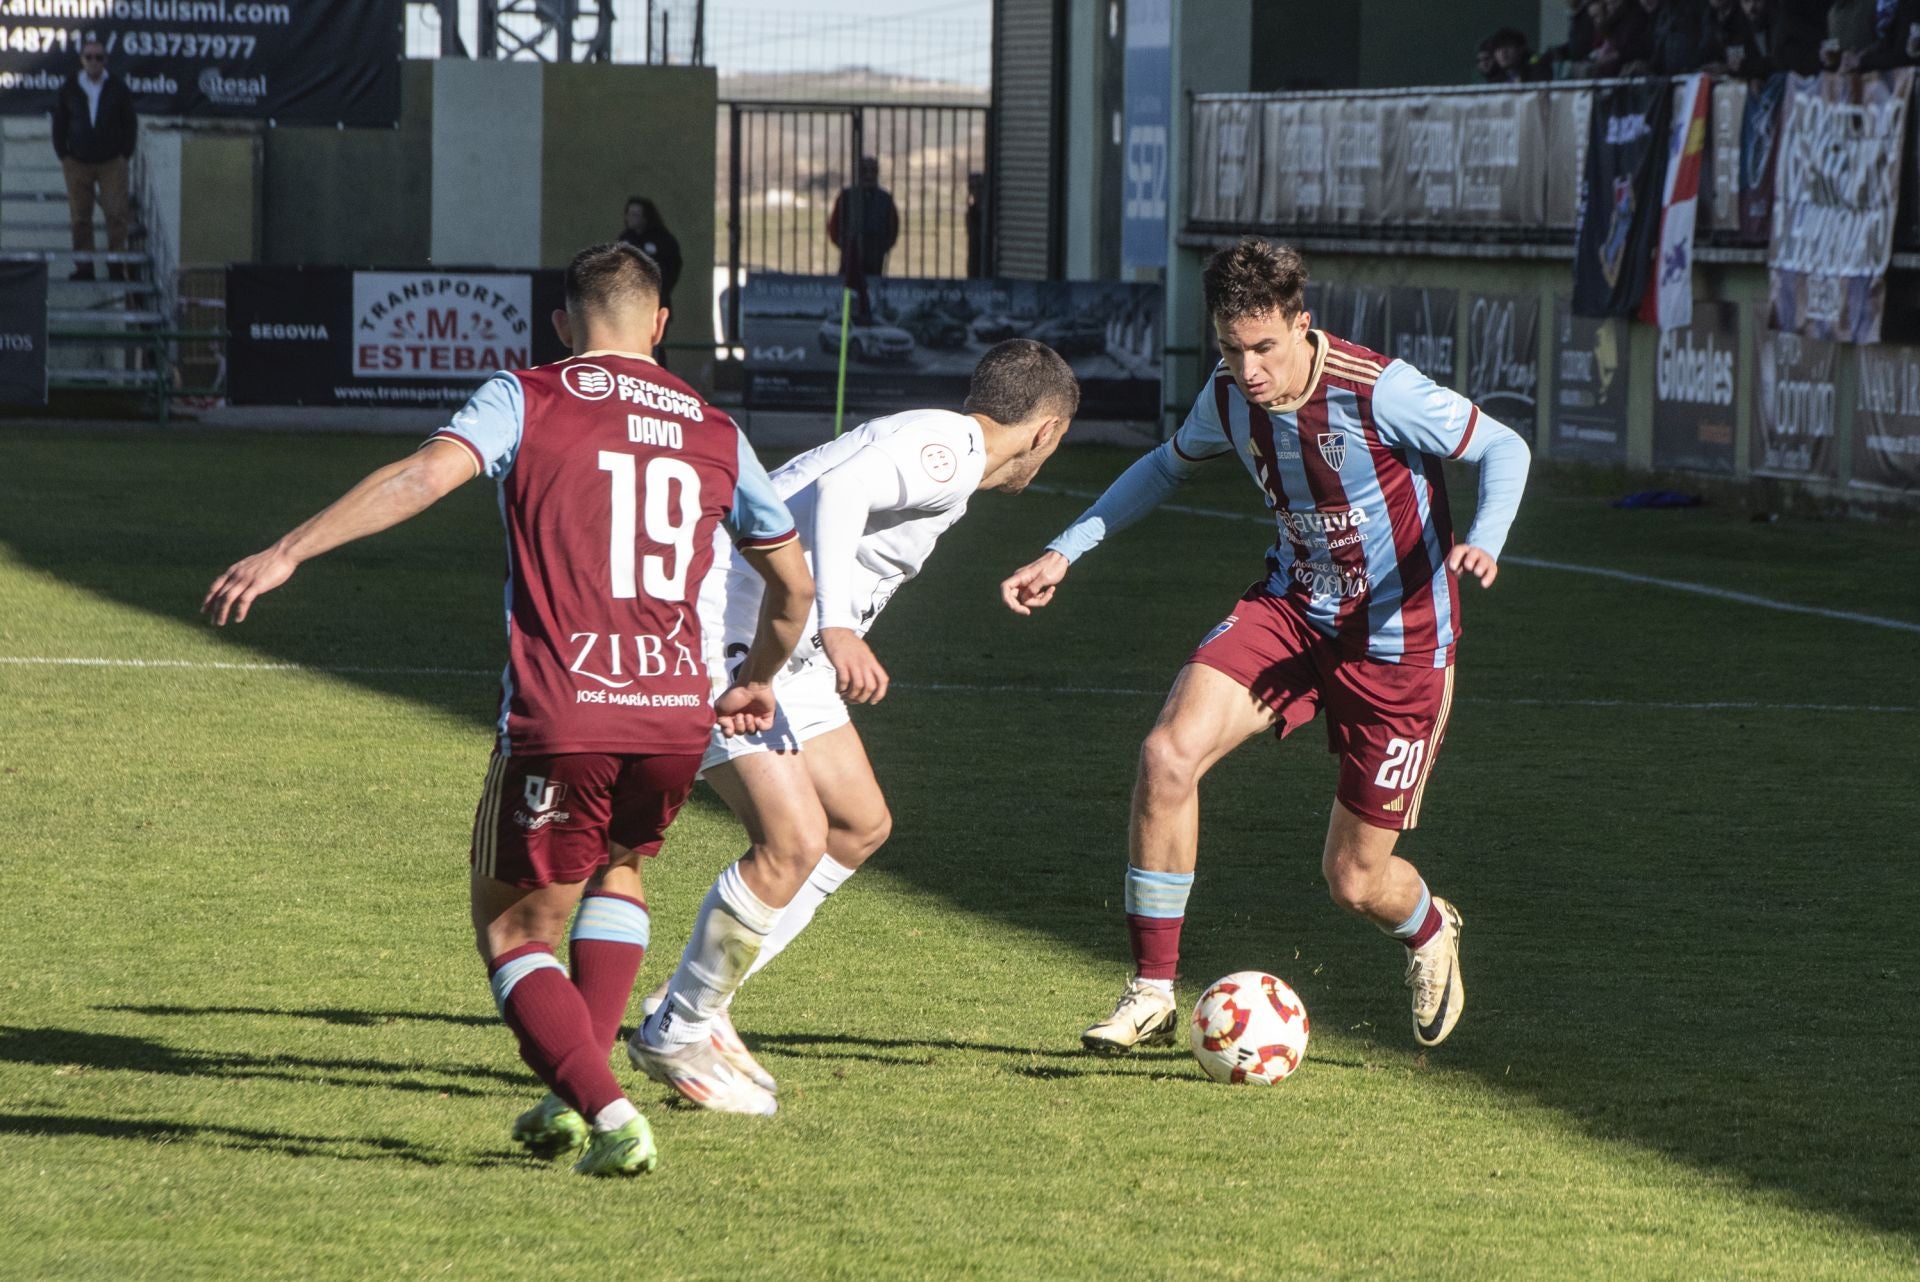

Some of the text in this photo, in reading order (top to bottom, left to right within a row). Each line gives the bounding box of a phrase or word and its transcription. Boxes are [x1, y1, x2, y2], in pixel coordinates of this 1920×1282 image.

[122, 31, 257, 59] 633737977
[360, 278, 528, 335] TRANSPORTES
[250, 324, 329, 340] SEGOVIA
[358, 344, 528, 371] ESTEBAN
[1656, 329, 1734, 405] Globales
[617, 374, 701, 408] OCTAVIANO
[618, 385, 704, 422] PALOMO
[627, 414, 683, 449] DAVO
[598, 450, 702, 601] 19
[569, 608, 698, 688] ZIBÁ
[576, 690, 700, 707] JOSÉ MARÍA EVENTOS
[1374, 737, 1425, 790] 20
